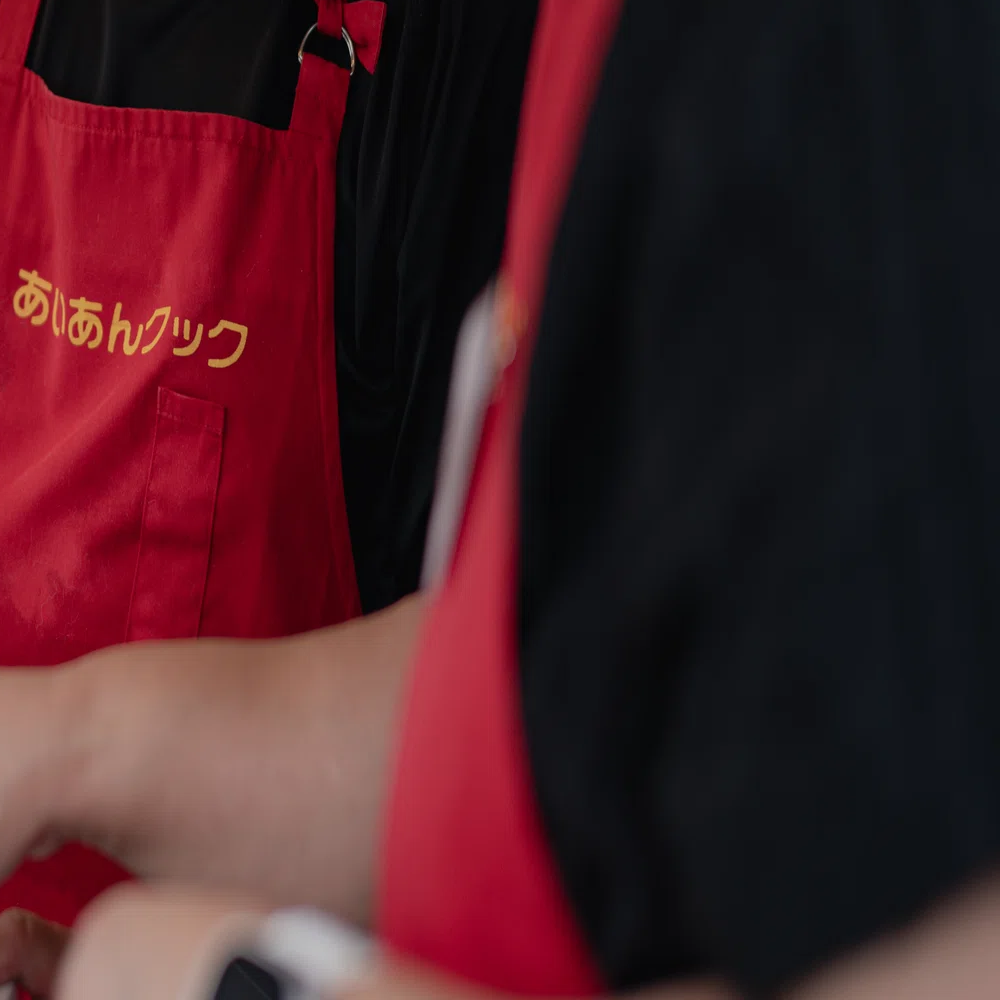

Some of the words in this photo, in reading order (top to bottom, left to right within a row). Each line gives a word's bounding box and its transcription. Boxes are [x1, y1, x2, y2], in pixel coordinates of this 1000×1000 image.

[13, 268, 248, 368] あいあんクック
